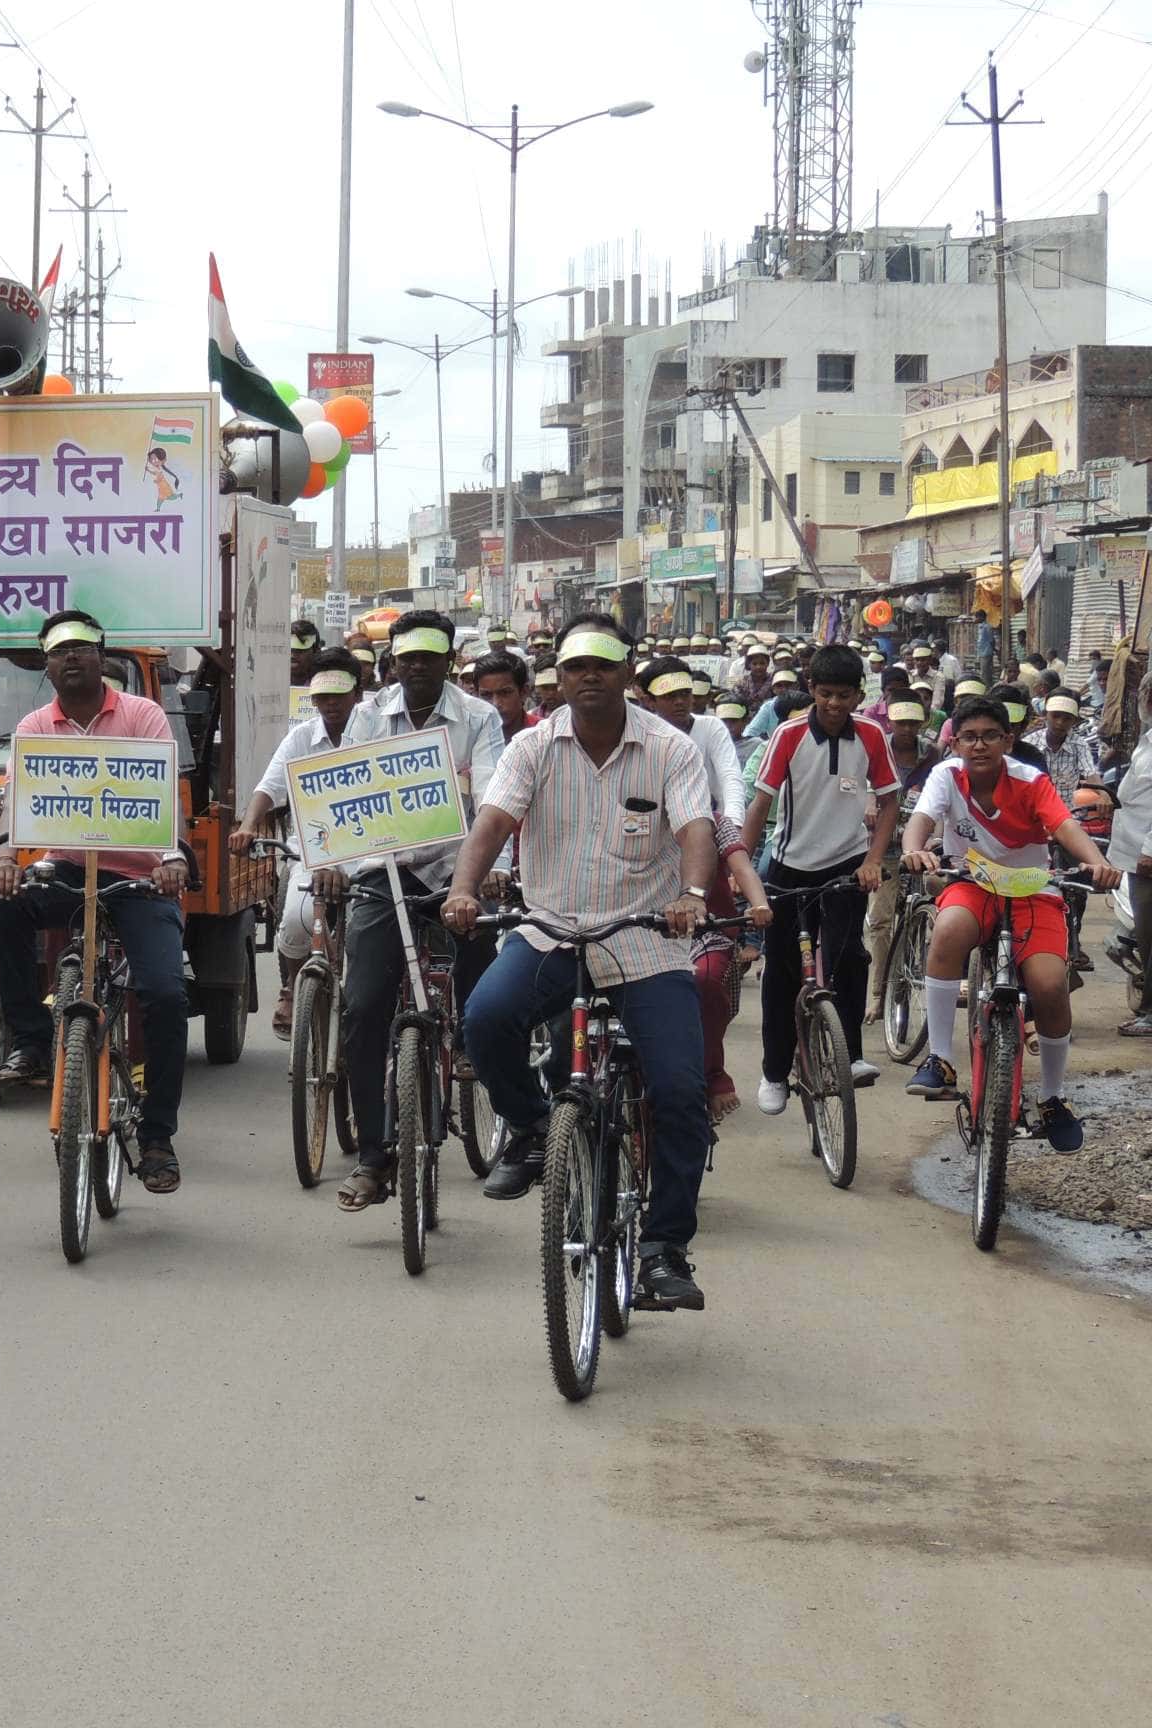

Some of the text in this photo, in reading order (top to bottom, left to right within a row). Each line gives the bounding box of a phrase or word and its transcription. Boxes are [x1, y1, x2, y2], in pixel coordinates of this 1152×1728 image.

[326, 359, 368, 369] INDIAN
[54, 442, 123, 501] दिन
[62, 514, 184, 558] साजरा
[24, 754, 167, 781] सायकल चालवा
[298, 745, 442, 797] सायकल चालवा
[30, 785, 161, 821] आरोग्य मिळवा
[329, 779, 449, 837] प्रदुषण टाळा
